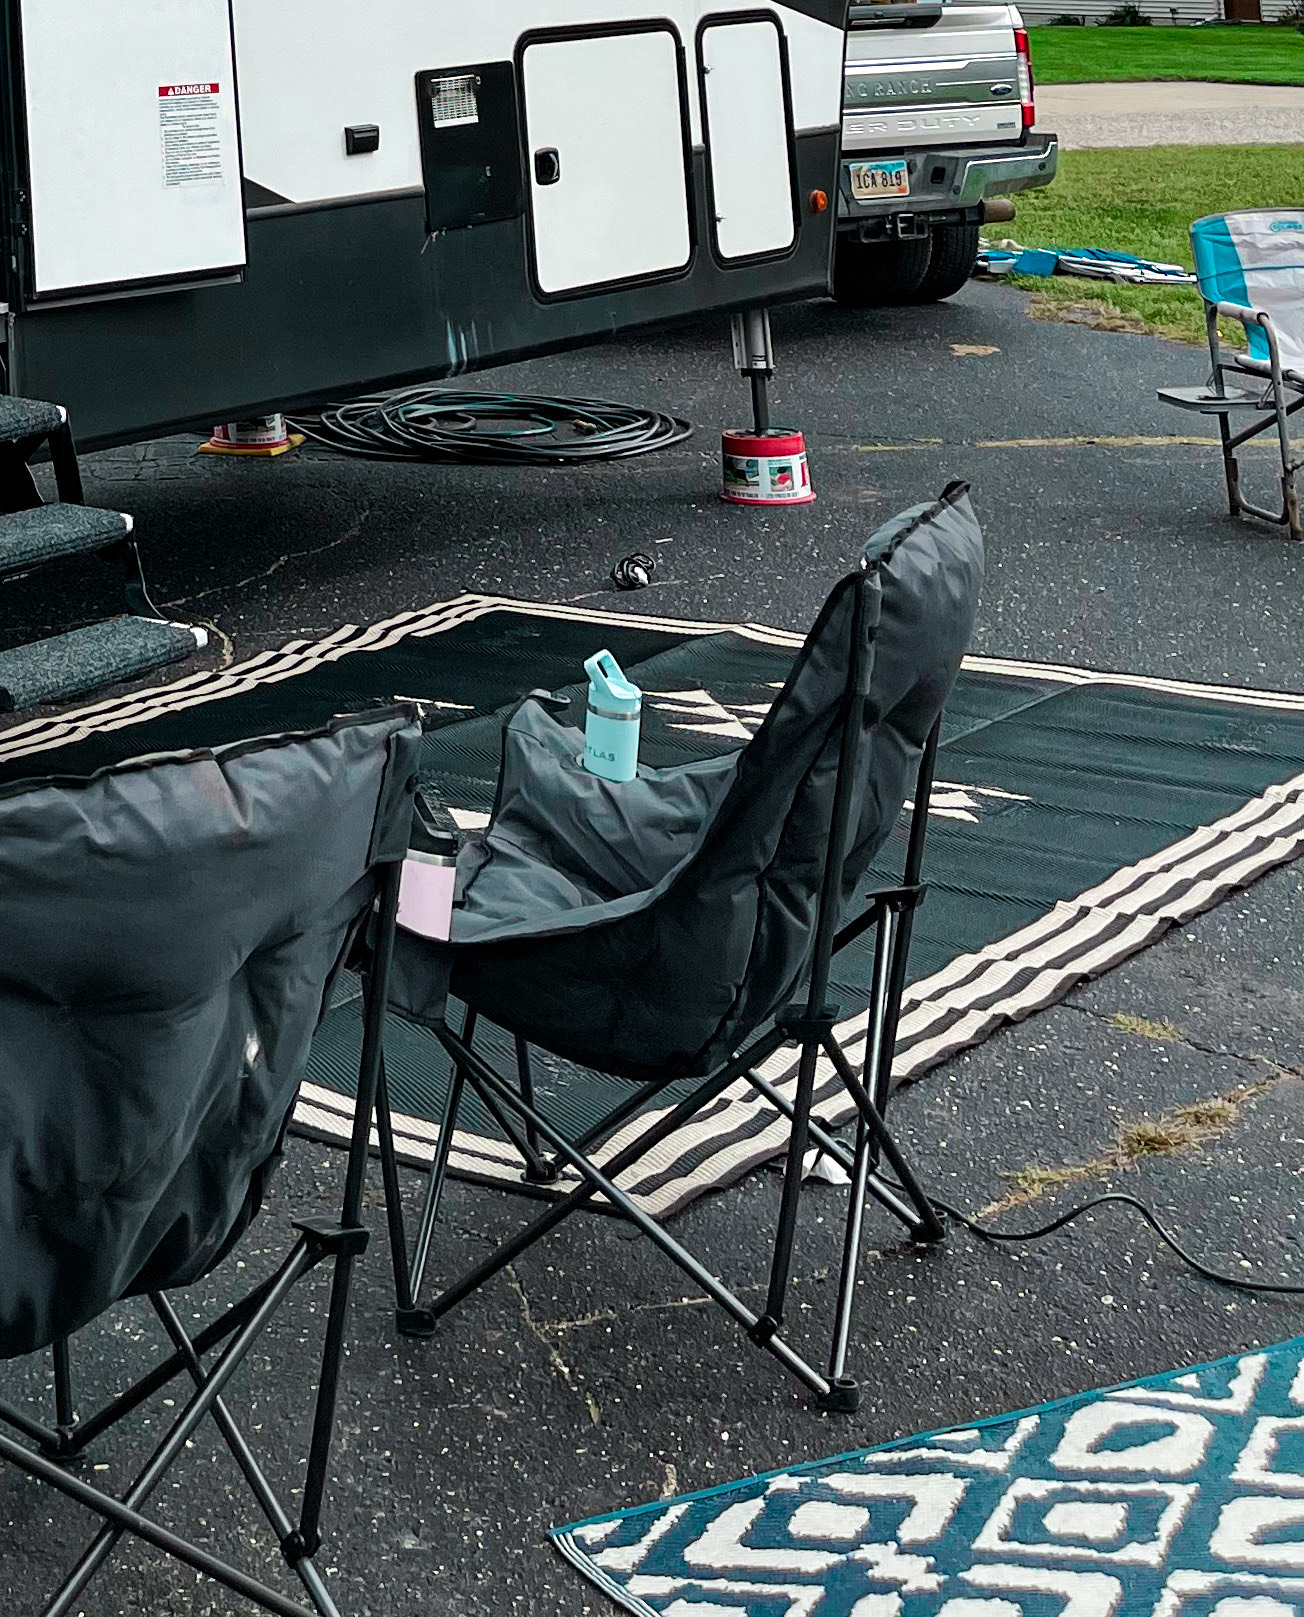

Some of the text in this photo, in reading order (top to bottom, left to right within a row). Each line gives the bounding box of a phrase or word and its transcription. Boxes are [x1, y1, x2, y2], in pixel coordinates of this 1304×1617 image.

[174, 84, 212, 96] DANGER
[874, 76, 932, 97] RANCH
[897, 115, 981, 132] DUTY
[881, 170, 902, 188] 819
